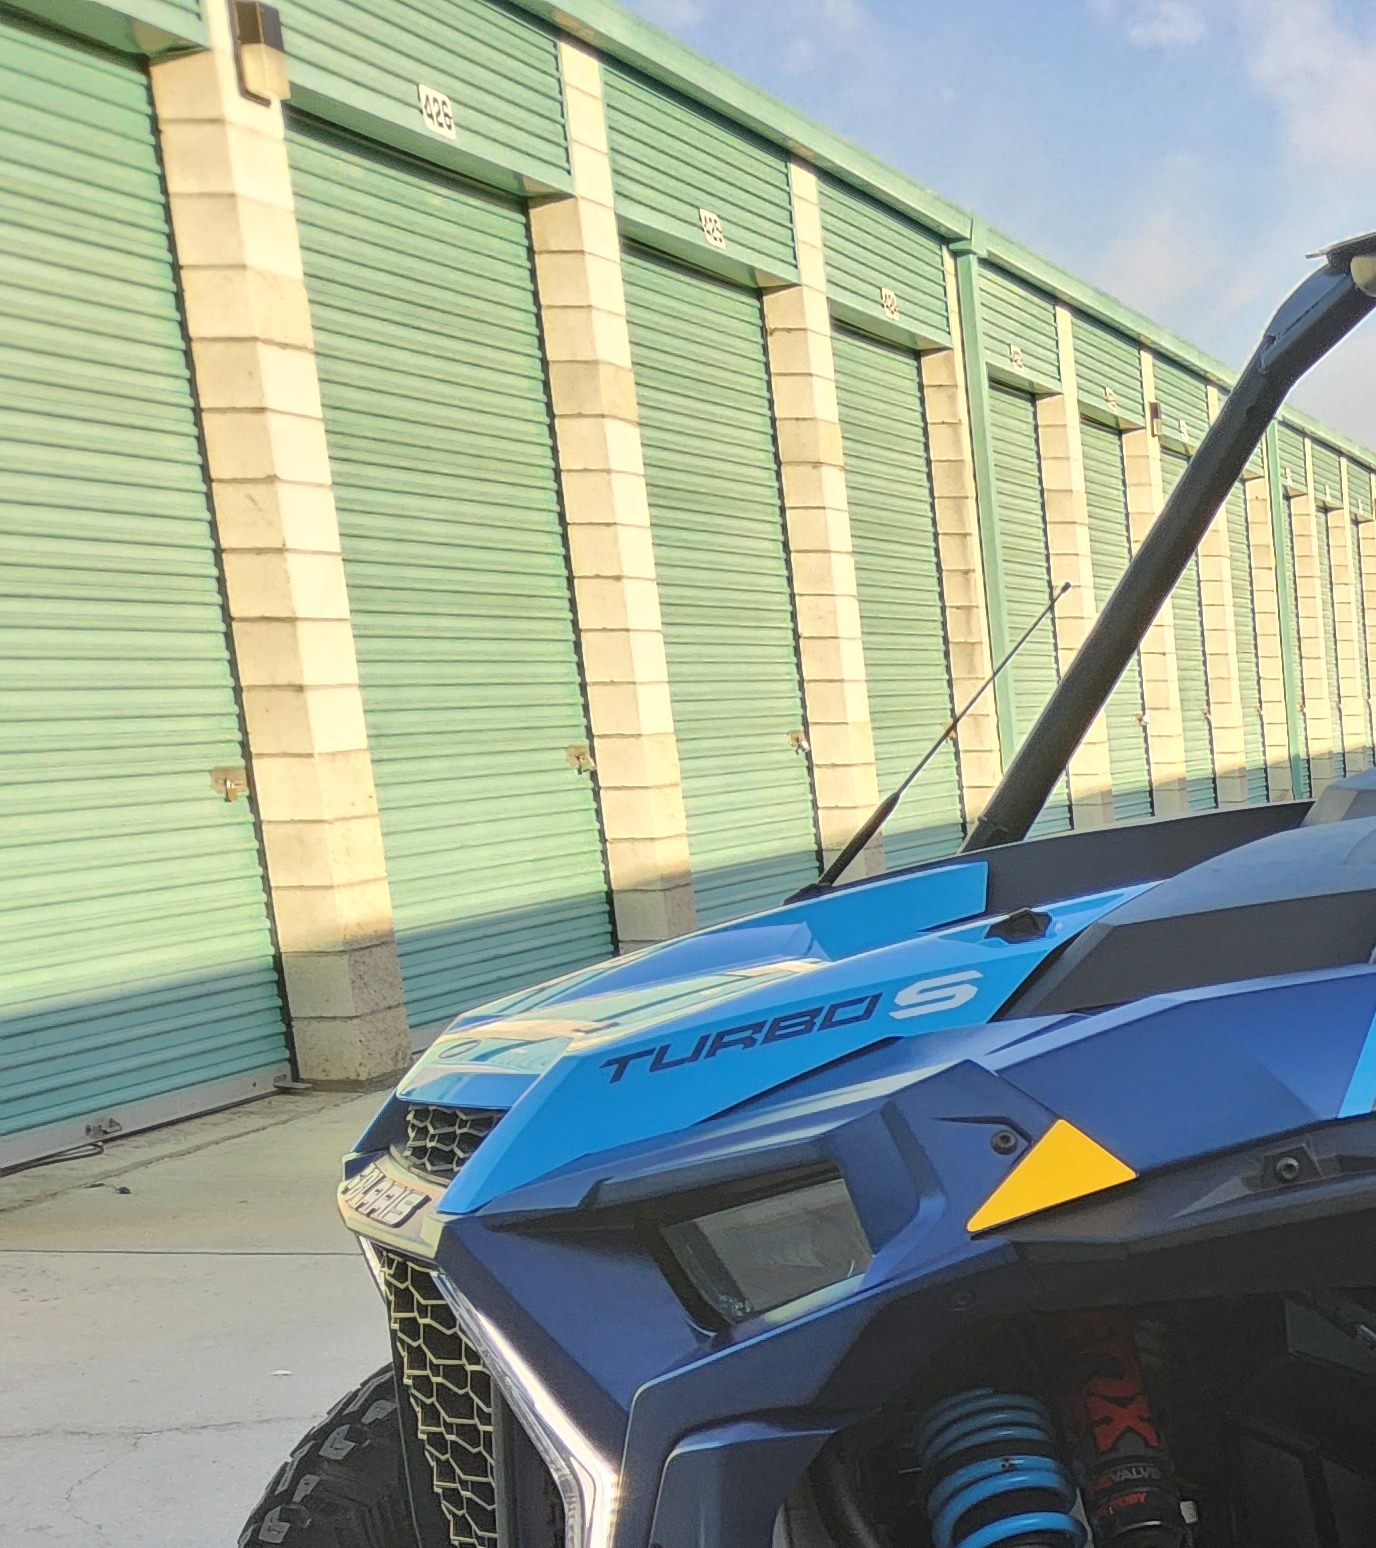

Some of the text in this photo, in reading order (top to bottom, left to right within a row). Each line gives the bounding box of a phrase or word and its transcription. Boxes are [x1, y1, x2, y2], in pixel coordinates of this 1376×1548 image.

[424, 94, 453, 131] 426
[600, 969, 984, 1084] TURBO S
